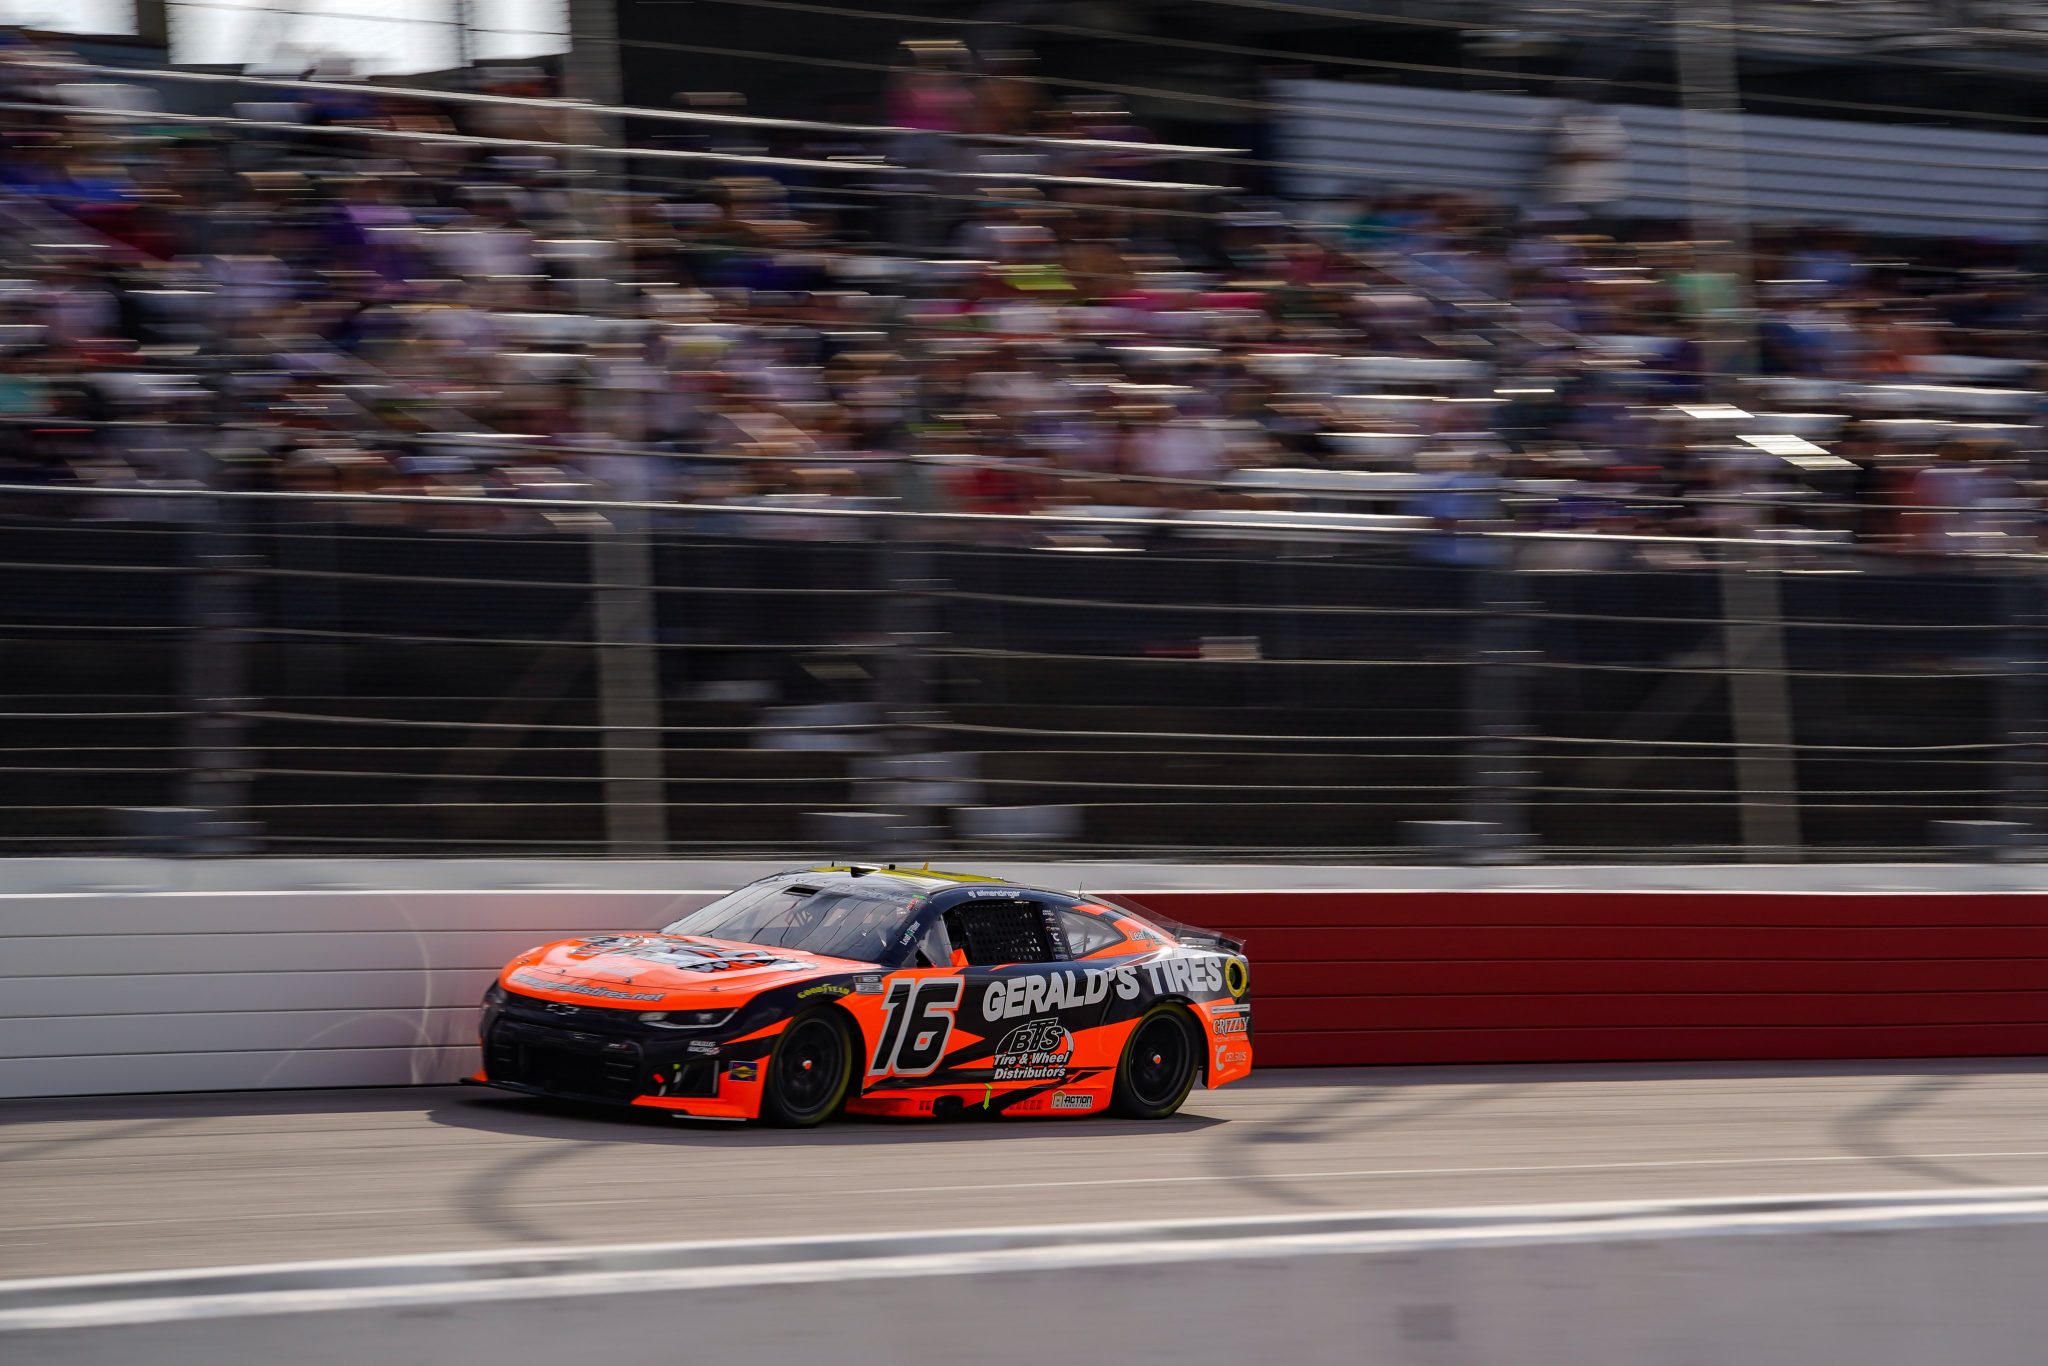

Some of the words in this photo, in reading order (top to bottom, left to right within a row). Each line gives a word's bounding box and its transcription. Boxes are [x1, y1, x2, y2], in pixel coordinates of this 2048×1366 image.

[797, 983, 850, 998] GOODYEAR
[982, 966, 1140, 1022] GERALD'S
[1143, 957, 1223, 995] TIRES
[868, 975, 964, 1076] 16
[1213, 1016, 1250, 1035] GRIZZLY
[1008, 1017, 1063, 1054] BTS
[994, 1054, 1016, 1066] Tire
[1019, 1053, 1028, 1064] &
[1031, 1051, 1069, 1064] Wheel
[994, 1066, 1066, 1079] Distributors
[1064, 1096, 1092, 1104] ACTION
